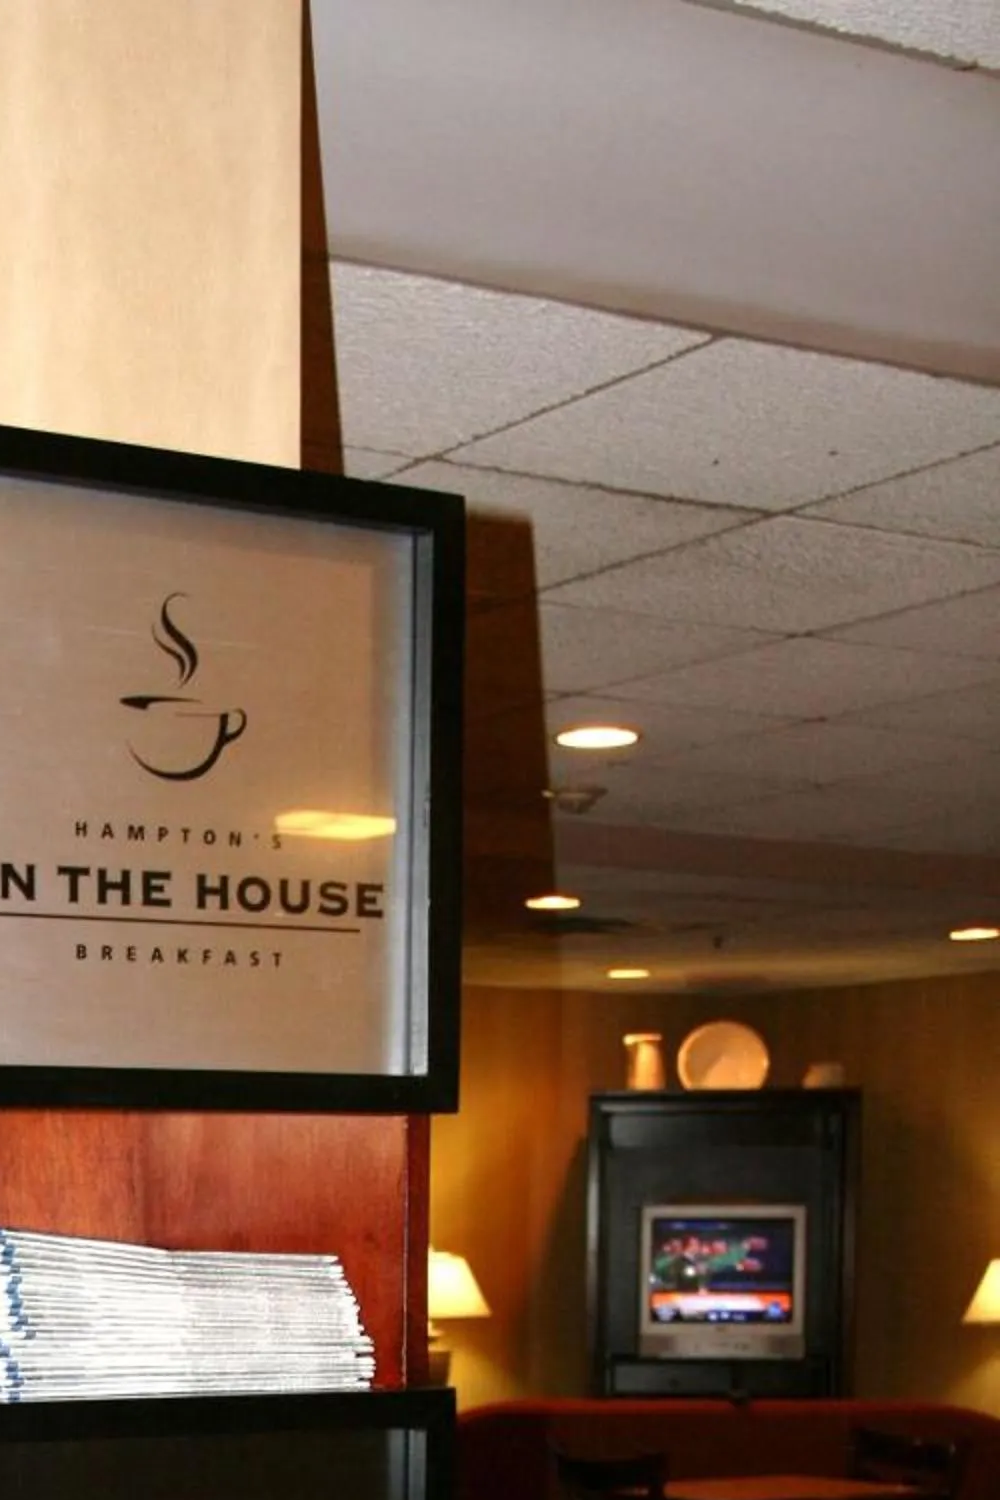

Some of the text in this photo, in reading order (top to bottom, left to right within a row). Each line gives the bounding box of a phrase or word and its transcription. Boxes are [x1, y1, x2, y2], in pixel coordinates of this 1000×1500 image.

[74, 821, 283, 850] HAMPTON'S
[56, 865, 173, 909] THE
[196, 873, 385, 920] HOUSE
[75, 943, 284, 967] BREAKFAST
